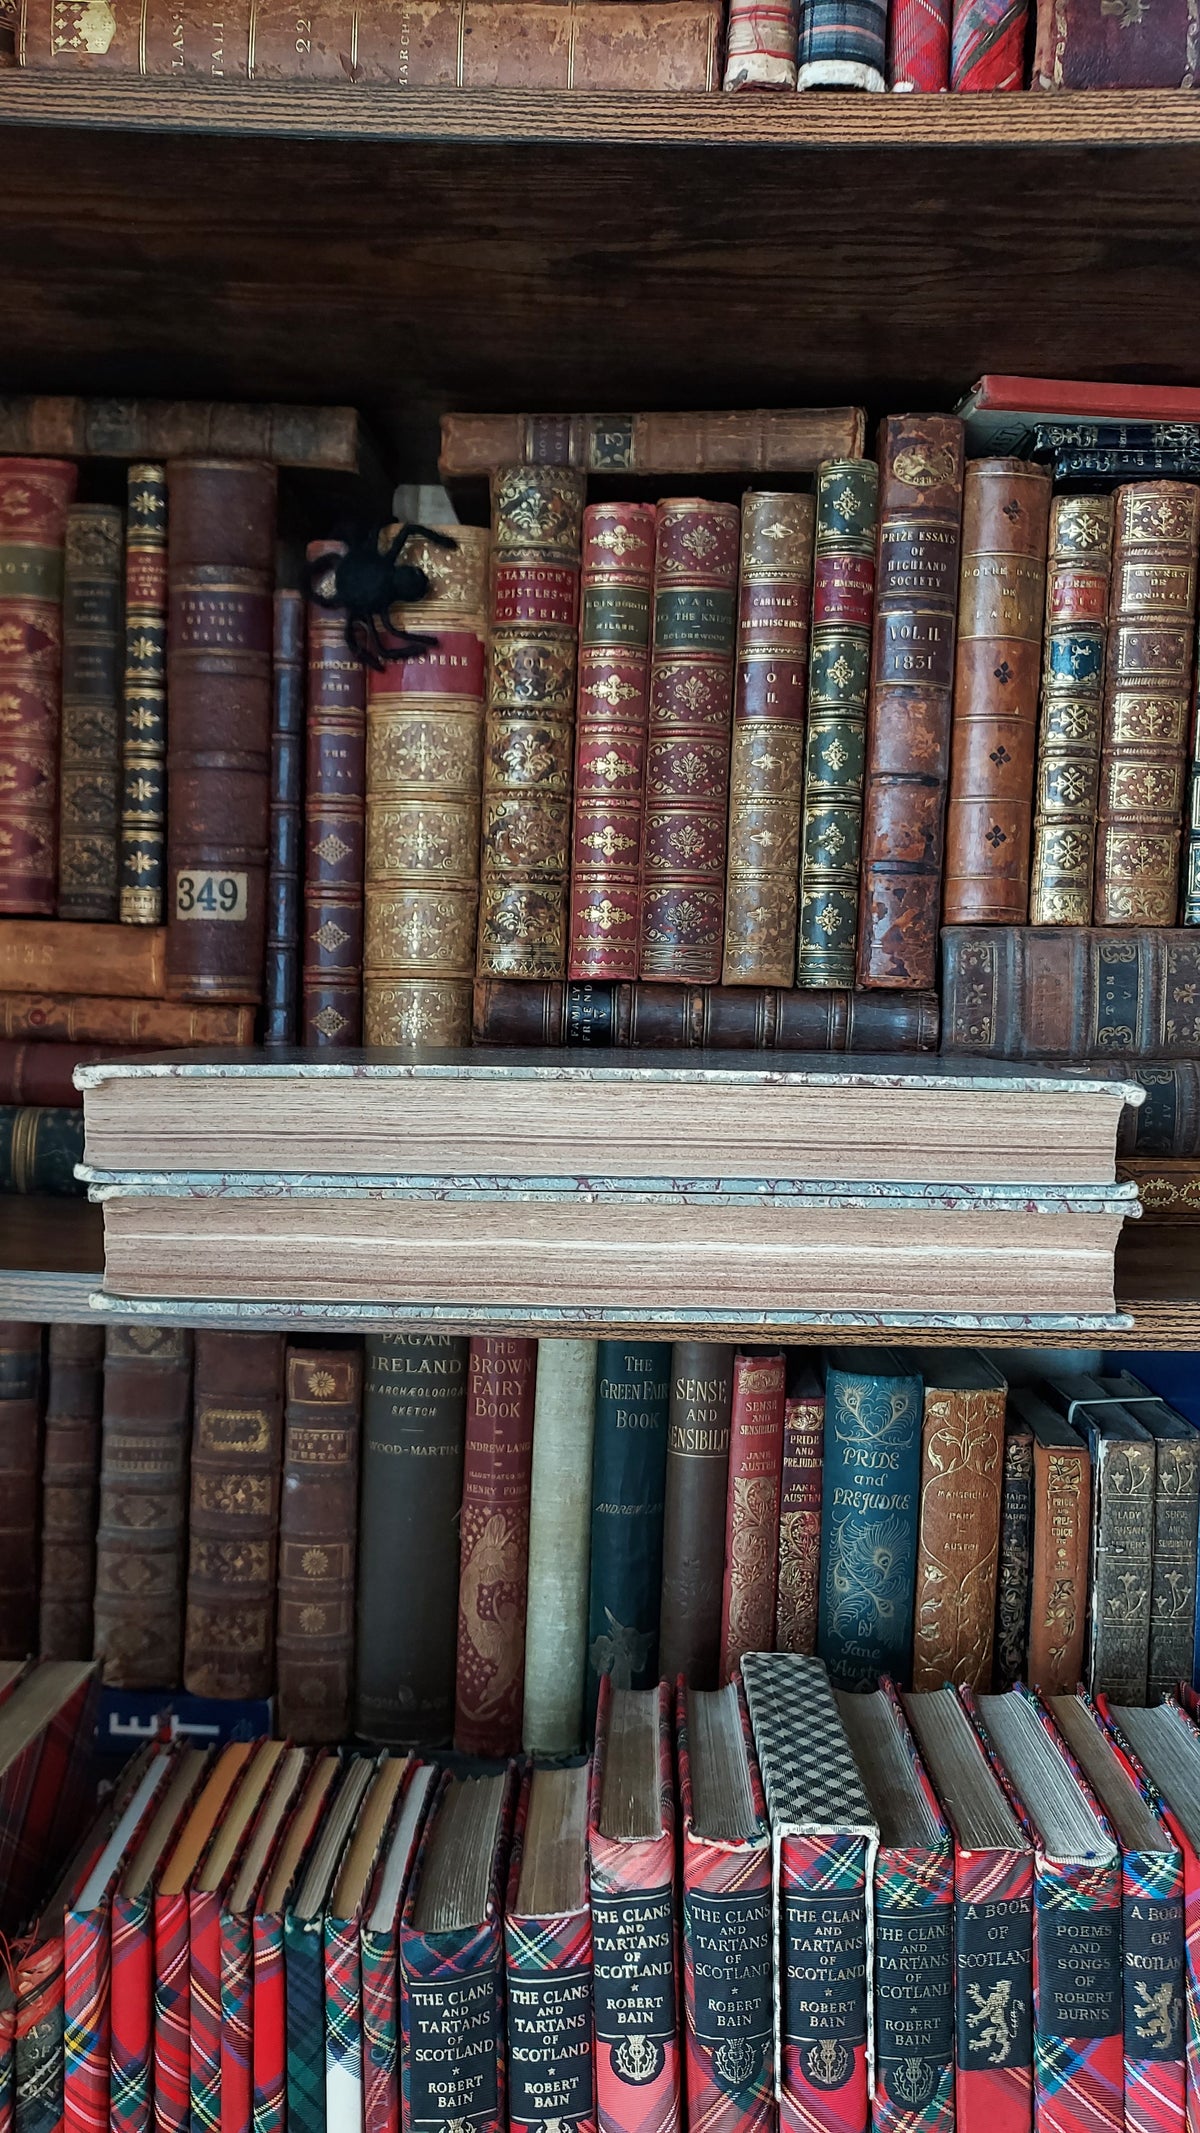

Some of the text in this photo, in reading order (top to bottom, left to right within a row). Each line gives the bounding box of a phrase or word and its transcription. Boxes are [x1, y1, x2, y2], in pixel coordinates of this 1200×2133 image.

[295, 18, 312, 53] 22
[882, 530, 956, 545] PRIZE ESSAYS
[910, 547, 924, 557] OF
[888, 561, 947, 573] HIGHLAND
[963, 566, 1008, 578] NOTRE
[889, 575, 942, 588] SOCIETY
[1150, 578, 1167, 586] DE
[497, 587, 558, 600] EPISTLES
[753, 594, 799, 607] CARLYLE'S
[586, 600, 648, 611] EDINBURGH
[677, 597, 714, 607] WAR
[496, 605, 568, 621] GOSPELS
[675, 612, 696, 621] THE
[890, 625, 925, 642] VOL.
[893, 654, 934, 670] 1831
[177, 876, 239, 913] 349
[1105, 975, 1115, 1016] TOM
[570, 986, 581, 1037] FAMILY
[582, 984, 593, 1042] FRIEND
[484, 1338, 516, 1354] THE
[371, 1356, 462, 1374] IRELAND
[469, 1353, 532, 1374] BROWN
[624, 1355, 653, 1372] THE
[378, 1384, 464, 1398] ARCHÆOLOGICA
[472, 1375, 525, 1396] FAIRY
[600, 1378, 670, 1400] GREEN FAIR
[675, 1377, 728, 1404] SENSE
[391, 1405, 437, 1417] SKETCH
[474, 1398, 521, 1418] BOOK
[745, 1399, 778, 1414] SENSE
[615, 1409, 661, 1429] BOOK
[686, 1408, 718, 1422] AND
[752, 1413, 771, 1423] AND
[739, 1423, 779, 1436] SENSIBILITY
[667, 1425, 731, 1452] ENSIBILIT
[789, 1434, 820, 1446] PRIDE
[368, 1441, 459, 1456] WOOD-MARTIN
[466, 1440, 506, 1453] ANDREW
[795, 1446, 814, 1456] AND
[746, 1449, 771, 1461] JANE
[783, 1455, 824, 1469] PREJUDICE
[842, 1445, 901, 1471] PRIDE
[740, 1460, 777, 1472] AUSTEN
[853, 1472, 889, 1488] and
[466, 1483, 498, 1496] HENRY
[789, 1483, 816, 1492] JANE
[783, 1492, 821, 1503] AUSTEN
[832, 1486, 912, 1516] PREJUDICE
[595, 1502, 641, 1515] ANDREW
[1117, 1511, 1142, 1520] LADY
[1113, 1526, 1145, 1535] SUSAN
[857, 1618, 876, 1638] by
[840, 1640, 881, 1659] Jane
[591, 1902, 671, 1923] THE CLANS
[691, 1903, 771, 1924] THE CLANS
[786, 1908, 817, 1923] THE
[964, 1899, 1031, 1920] A BOOK
[1130, 1906, 1144, 1920] A
[617, 1923, 645, 1935] AND
[719, 1925, 746, 1936] AND
[814, 1926, 842, 1936] AND
[987, 1926, 1009, 1940] OF
[1056, 1925, 1112, 1938] POEMS
[594, 1932, 670, 1951] TARTANS
[696, 1934, 768, 1952] TARTANS
[790, 1935, 864, 1953] TARTANS
[1151, 1932, 1171, 1945] OF
[899, 1944, 928, 1954] AND
[1068, 1943, 1101, 1954] AND
[624, 1952, 641, 1962] OF
[725, 1954, 742, 1964] OF
[819, 1955, 837, 1966] OF
[877, 1953, 949, 1970] TARTANS
[1057, 1958, 1111, 1970] SONGS
[594, 1960, 673, 1979] SCOTLAND
[695, 1961, 771, 1980] SCOTLAND
[787, 1964, 865, 1981] SCOTLAND
[905, 1972, 923, 1983] OF
[1074, 1975, 1095, 1986] OF
[412, 1982, 494, 2006] THE CLANS
[510, 1983, 590, 2005] THE CLANS
[1053, 1992, 1114, 2003] ROBERT
[606, 1997, 664, 2010] ROBERT
[708, 1997, 762, 2012] ROBERT
[799, 2001, 856, 2014] ROBERT
[441, 2006, 469, 2018] AND
[536, 2005, 564, 2017] AND
[617, 2011, 654, 2024] BAIN
[1056, 2008, 1110, 2020] BURNS
[418, 2011, 491, 2034] TARTANS
[514, 2014, 586, 2033] TARTANS
[717, 2014, 752, 2027] BAIN
[809, 2016, 846, 2027] BAIN
[885, 2017, 941, 2032] ROBERT
[447, 2035, 464, 2046] OF
[542, 2034, 559, 2045] OF
[894, 2033, 932, 2046] BAIN
[415, 2039, 494, 2062] SCOTLAND
[512, 2041, 590, 2062] SCOTLAND
[428, 2074, 484, 2094] ROBERT
[523, 2076, 579, 2094] ROBERT
[437, 2092, 474, 2108] BAIN
[534, 2093, 570, 2108] BAIN
